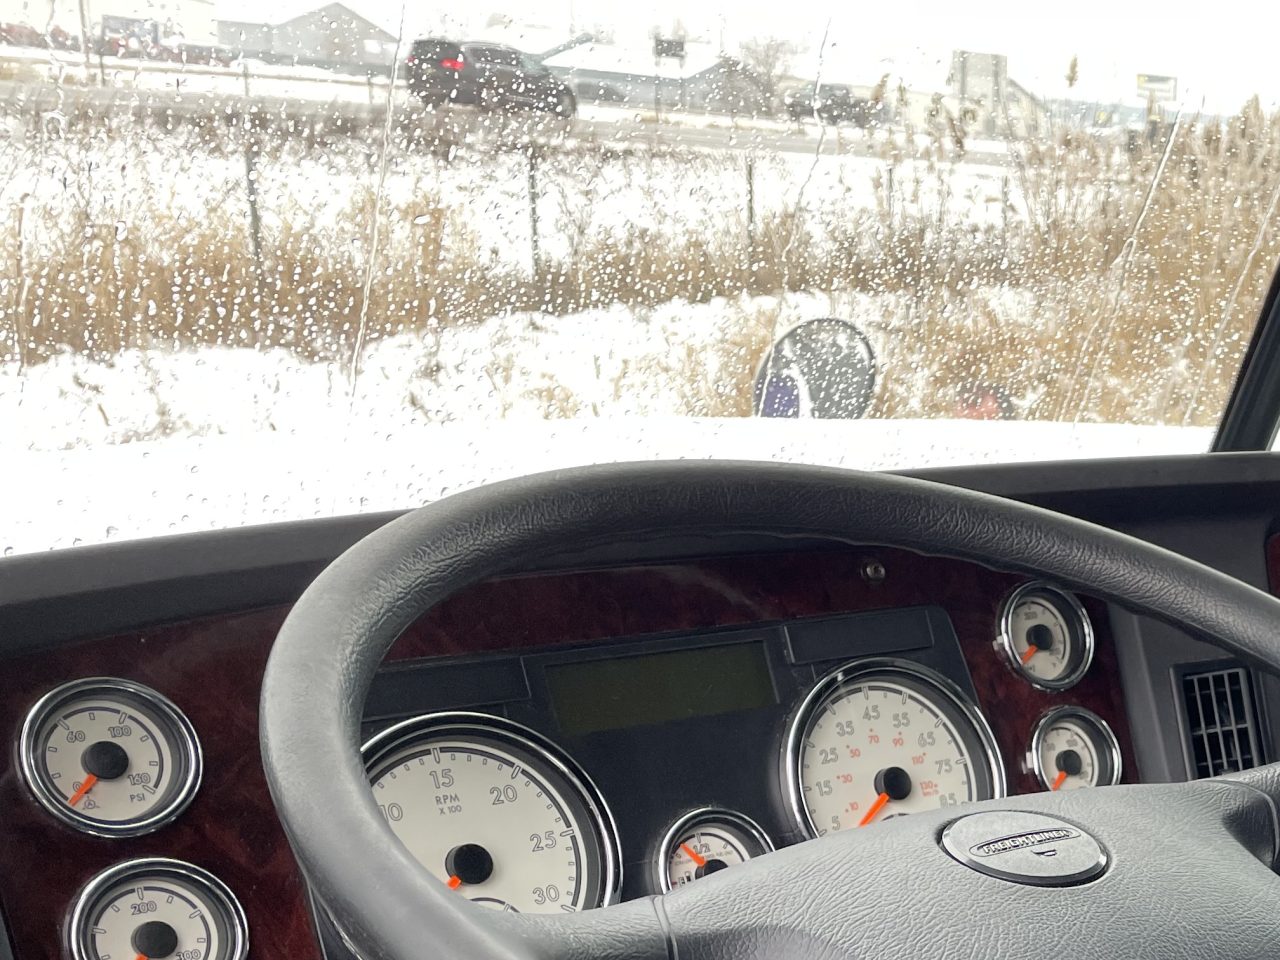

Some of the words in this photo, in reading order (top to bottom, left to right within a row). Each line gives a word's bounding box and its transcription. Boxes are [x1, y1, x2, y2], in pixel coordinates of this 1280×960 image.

[862, 704, 881, 720] 45
[892, 712, 910, 728] 55
[108, 725, 132, 738] 100
[836, 721, 855, 737] 35
[66, 730, 86, 743] 60
[868, 734, 880, 744] 70
[893, 737, 904, 748] 90
[918, 732, 936, 747] 65
[819, 747, 839, 765] 25
[850, 748, 861, 759] 50
[912, 755, 924, 765] 110
[935, 759, 953, 775] 75
[128, 772, 151, 786] 160
[429, 768, 455, 789] 15
[841, 774, 853, 784] 30
[920, 780, 934, 790] 130
[489, 785, 518, 806] 20
[815, 780, 833, 797] 15
[129, 793, 146, 803] PSI
[435, 793, 460, 806] RPM
[439, 806, 446, 815] X
[447, 804, 463, 814] 100
[850, 801, 859, 811] 10
[832, 816, 841, 831] 5
[529, 831, 557, 852] 25
[982, 829, 1070, 855] FREIGHTLINER
[693, 843, 711, 855] 1/2
[532, 885, 560, 905] 30
[130, 901, 157, 916] 200
